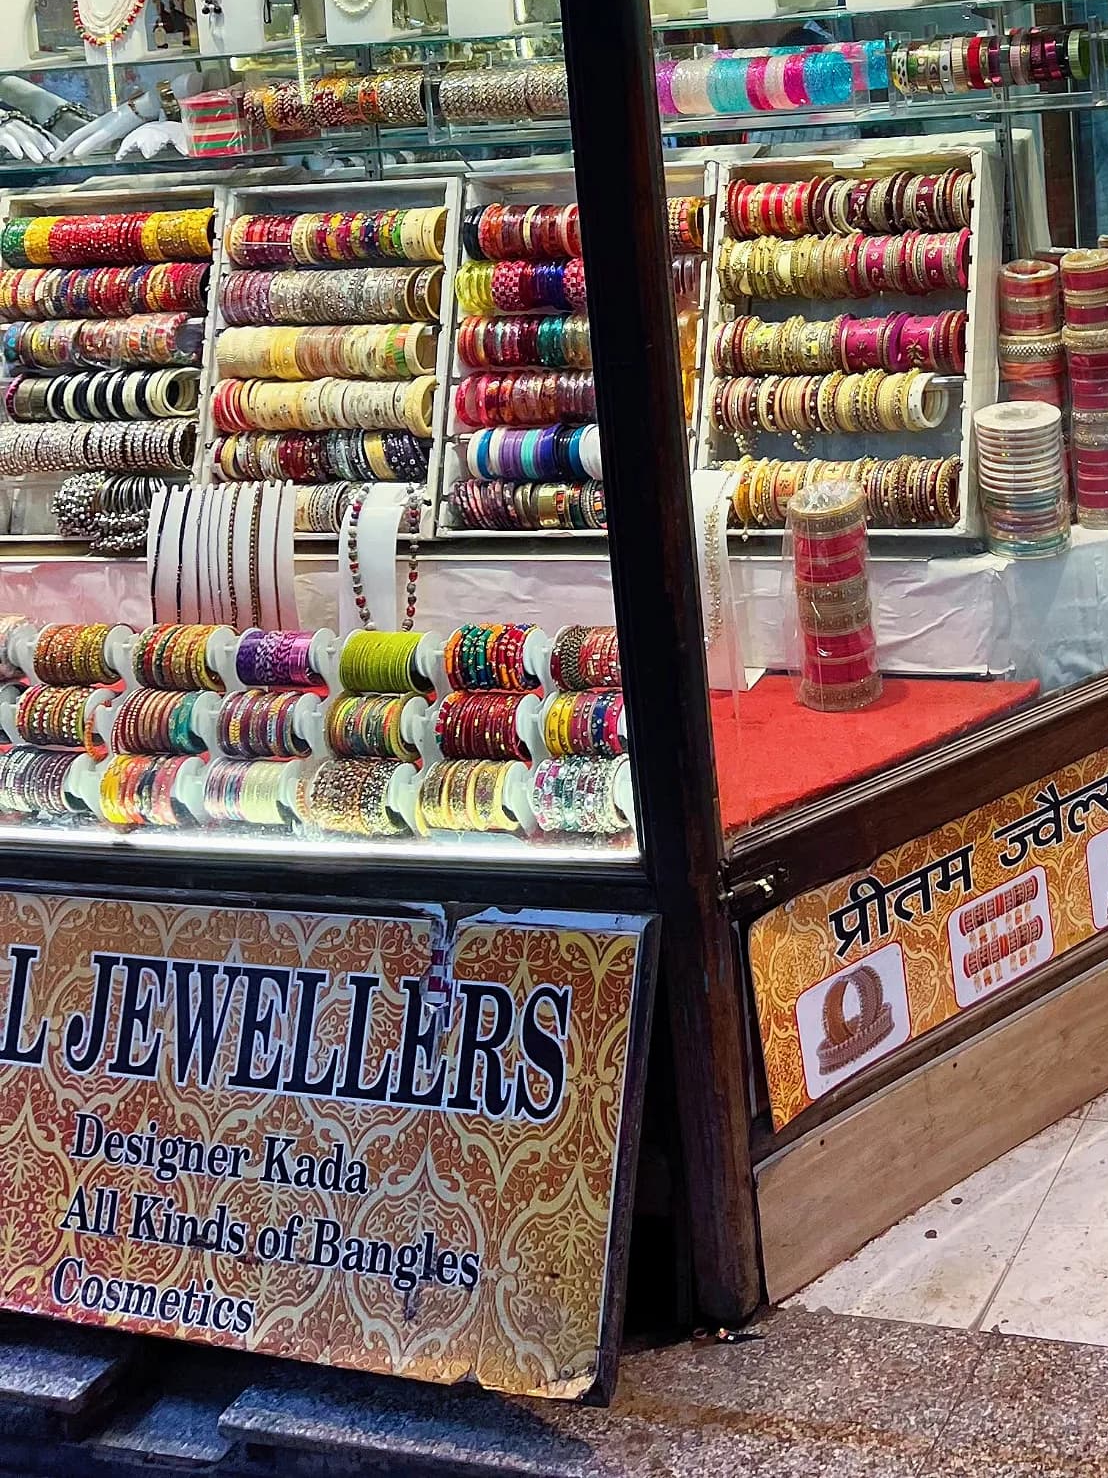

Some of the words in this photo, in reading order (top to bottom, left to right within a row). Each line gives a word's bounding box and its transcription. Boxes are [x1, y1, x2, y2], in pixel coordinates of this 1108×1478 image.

[829, 844, 974, 958] प्रीतम
[66, 954, 569, 1121] JEWELLERS
[73, 1114, 250, 1179] Designer
[263, 1136, 368, 1194] Kada
[60, 1186, 116, 1237] All
[129, 1193, 245, 1257] Kinds
[257, 1216, 303, 1262] of
[309, 1218, 481, 1292] Bangles
[53, 1257, 256, 1334] Cosmetics
